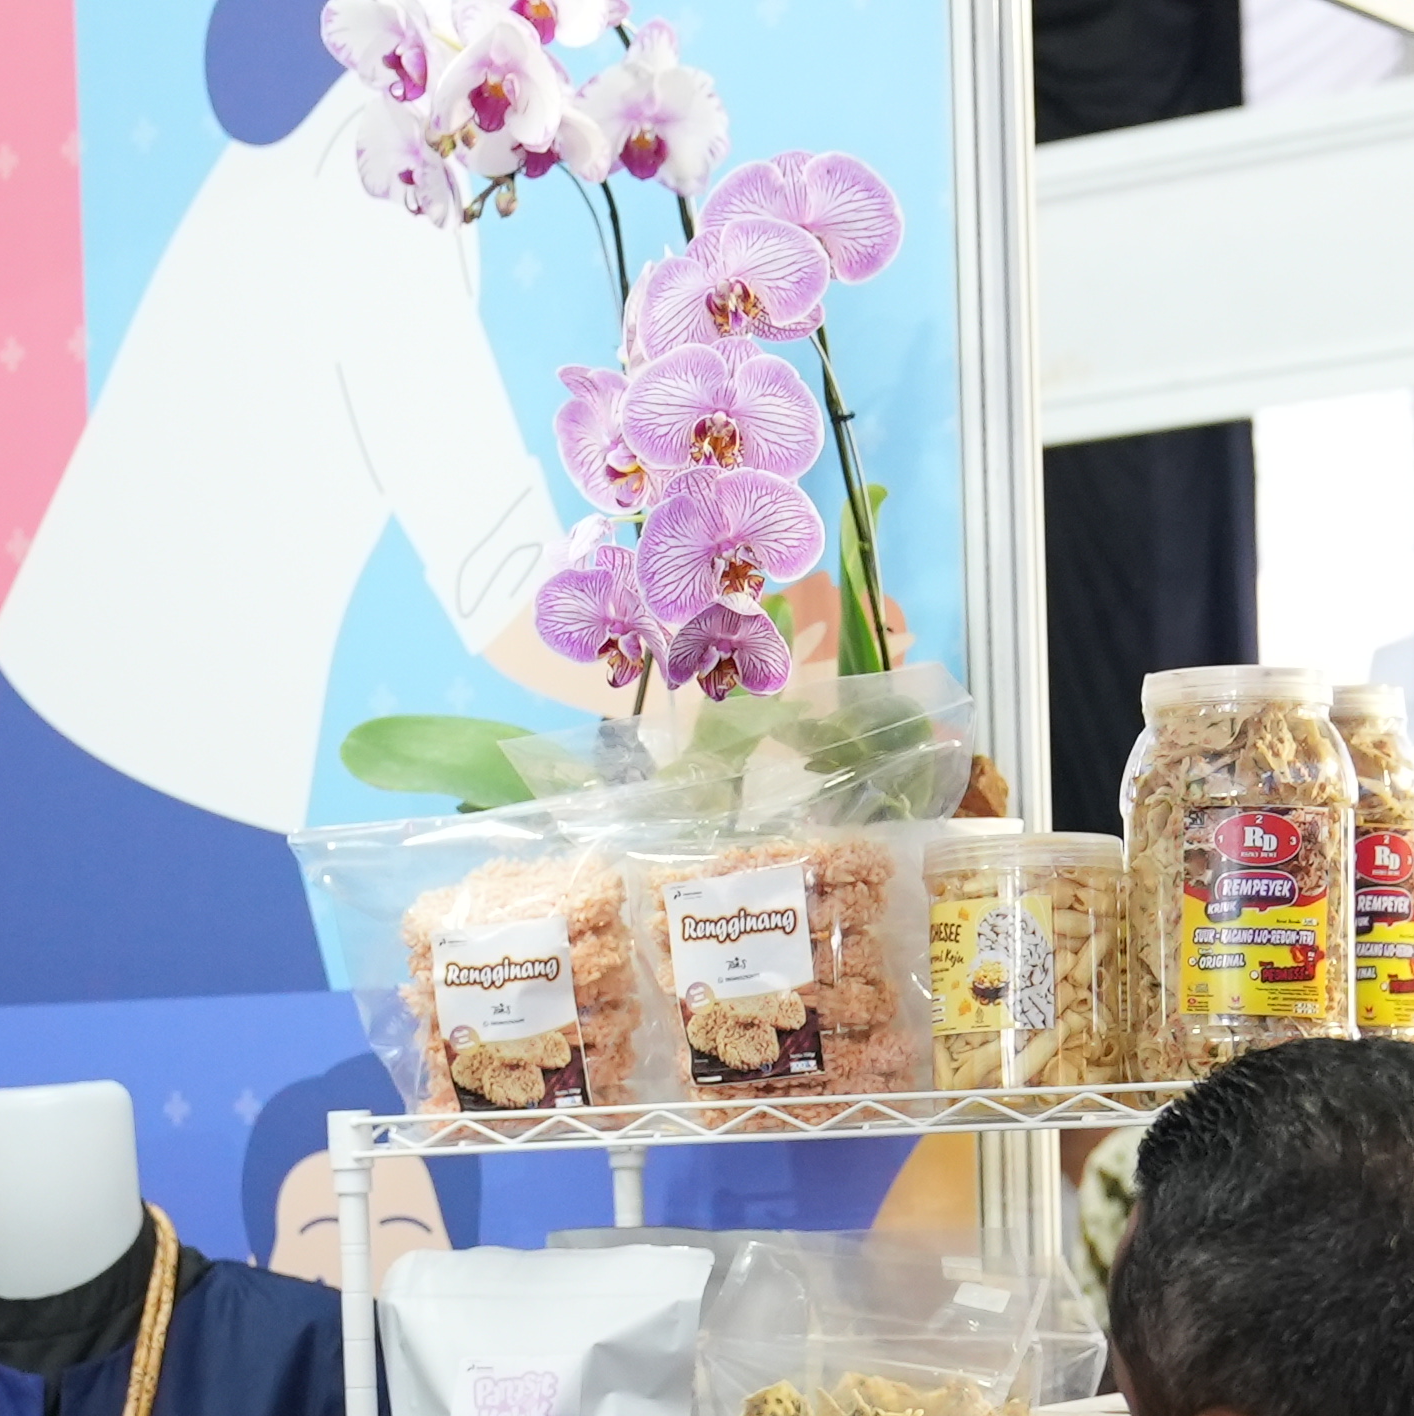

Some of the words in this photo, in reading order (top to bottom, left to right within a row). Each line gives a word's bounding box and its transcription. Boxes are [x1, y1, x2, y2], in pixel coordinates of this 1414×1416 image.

[1255, 815, 1264, 824] 2
[1217, 834, 1224, 844] 1
[1243, 826, 1278, 852] RD
[1289, 835, 1297, 846] 3
[1374, 845, 1401, 871] RD
[1222, 878, 1293, 898] REMPEYEK
[1356, 895, 1410, 913] REMPEYEK
[682, 908, 797, 943] Rengginang
[1199, 953, 1246, 970] ORIGINAL
[445, 956, 560, 989] Rengginang
